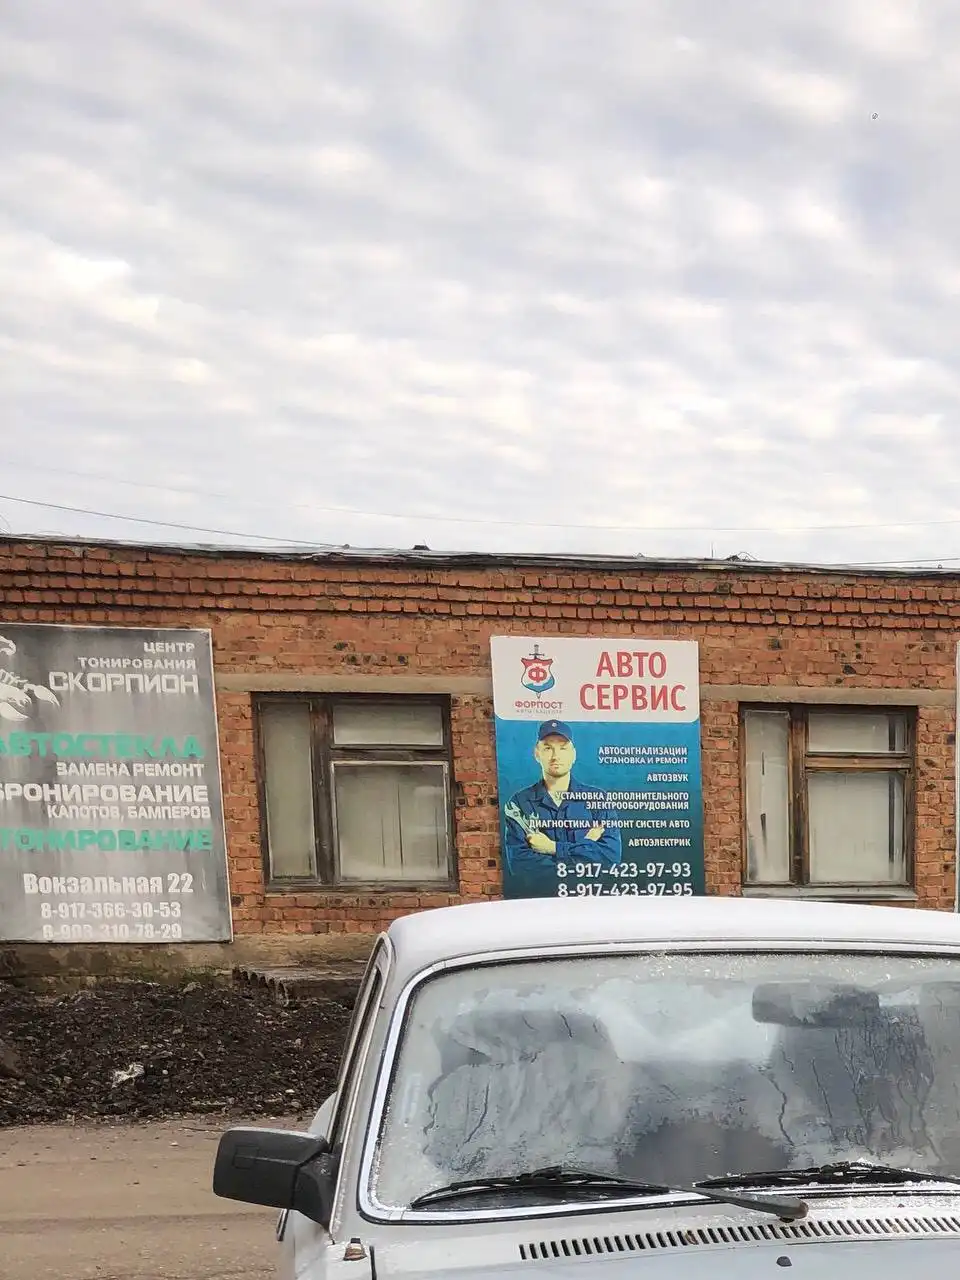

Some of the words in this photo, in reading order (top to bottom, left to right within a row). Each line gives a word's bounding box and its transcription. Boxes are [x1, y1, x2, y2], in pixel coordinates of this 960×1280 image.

[143, 641, 196, 654] ЦЕНТР
[78, 657, 196, 669] ТОНИРОВАНИЯ
[596, 651, 667, 678] АВТО
[48, 671, 199, 694] СКОРПИОН
[579, 683, 686, 711] СЕРВИС
[514, 700, 563, 710] ФОРПОСТ
[598, 746, 688, 756] АВТОСИГНАЛИЗАЦИИ
[56, 761, 130, 777] ЗАМЕНА
[133, 763, 204, 777] РЕМОНТ
[647, 773, 689, 782] АВТОЗВУК
[556, 792, 604, 800] УСТАНОВКА
[606, 792, 689, 802] ДОПОЛНИТЕЛЬНОГО
[47, 804, 124, 821] КАПОТОВ,
[127, 806, 211, 819] БАМПЕРОВ
[586, 801, 689, 811] ЭЛЕКТРООБОРУДОВАНИЯ
[529, 820, 590, 829] ДИАГНОСТИКА
[592, 820, 599, 828] И
[601, 820, 634, 828] РЕМОНТ
[635, 820, 667, 828] СИСТЕМ
[669, 820, 690, 828] АВТО
[628, 838, 691, 847] АВТОЭЛЕКТРИК
[556, 862, 691, 878] 8-917-423-97-93
[23, 873, 163, 894] Вокзальная
[167, 872, 194, 893] 22
[557, 883, 693, 898] 8-917-423-97-95
[41, 902, 182, 918] 8-917-366-30-53
